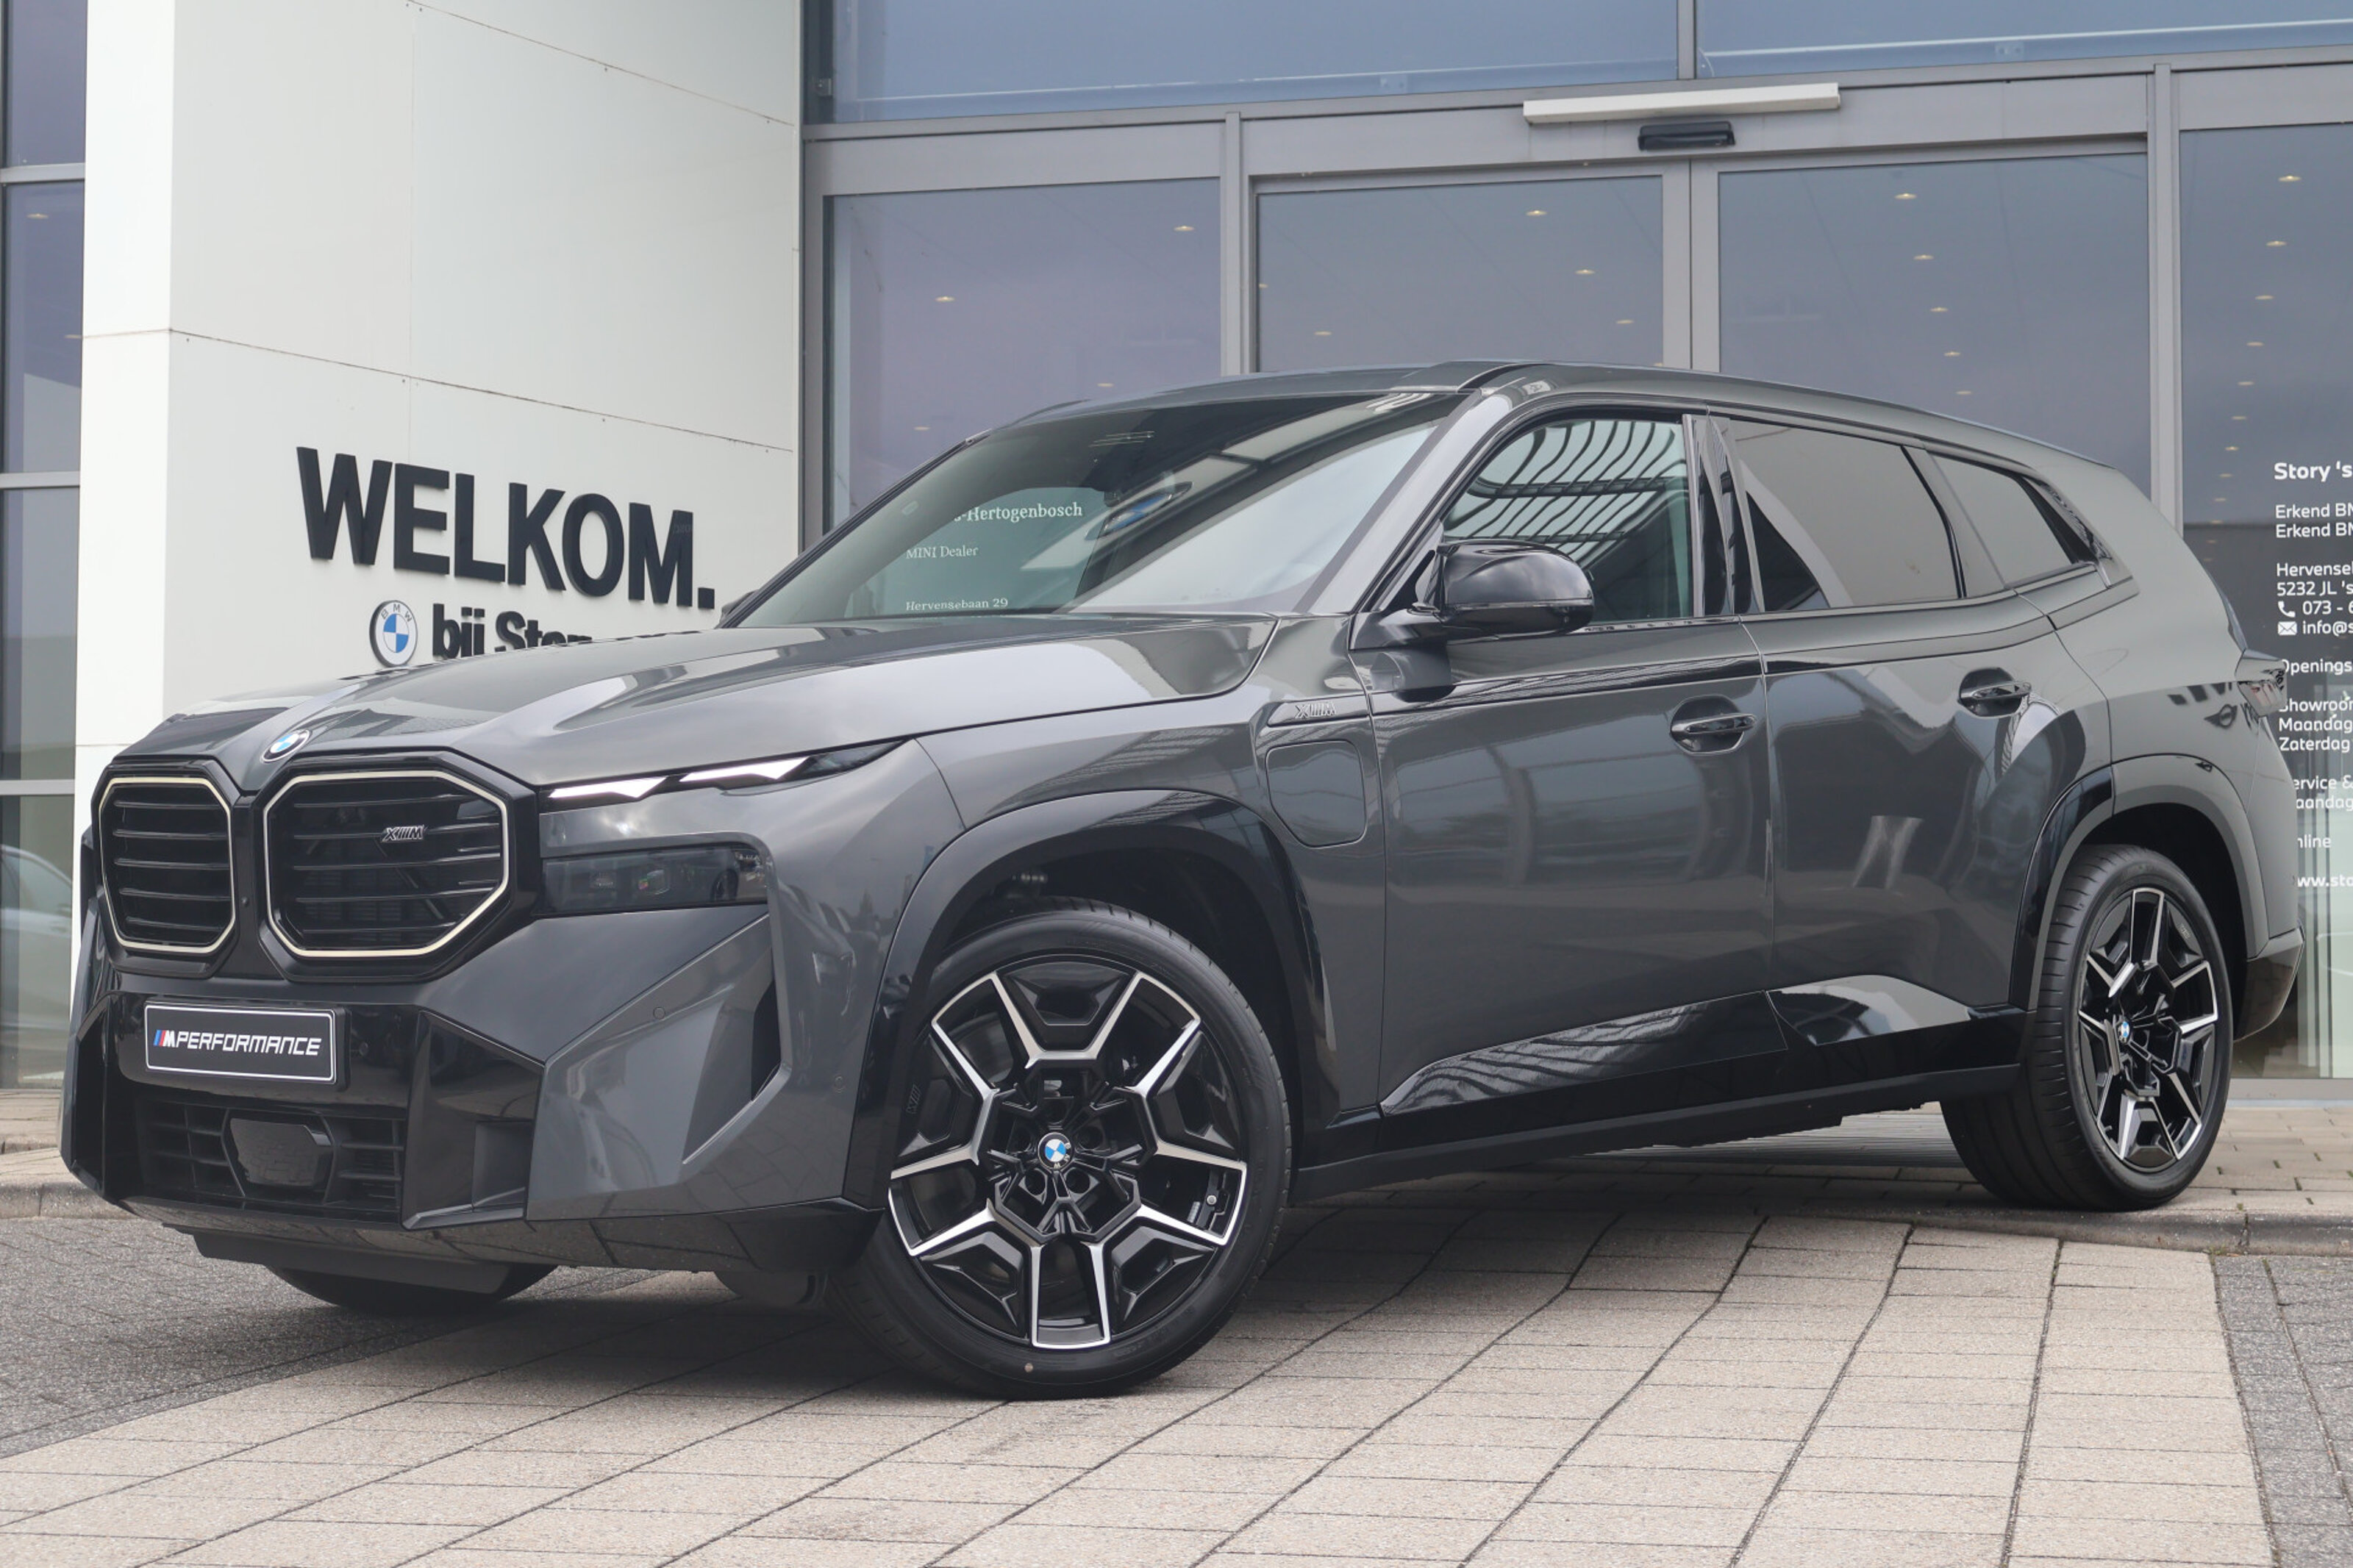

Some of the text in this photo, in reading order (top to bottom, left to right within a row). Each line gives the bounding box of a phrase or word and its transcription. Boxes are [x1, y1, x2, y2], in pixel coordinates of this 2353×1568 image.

[2274, 462, 2331, 482] Story
[2275, 503, 2330, 519] Erkend
[296, 446, 715, 609] WELKOM.
[2276, 523, 2330, 538] Erkend
[906, 545, 979, 559] MINI Dealer
[2277, 561, 2353, 577] Hervense
[2277, 581, 2315, 596] 5232
[2319, 581, 2338, 597] JL
[905, 598, 1009, 611] Hervensebaan 29
[2302, 600, 2332, 615] 073
[2279, 717, 2353, 734] Maandag
[2279, 736, 2351, 753] Zaterdag
[2293, 775, 2338, 790] ervice
[2296, 795, 2353, 812] aandag
